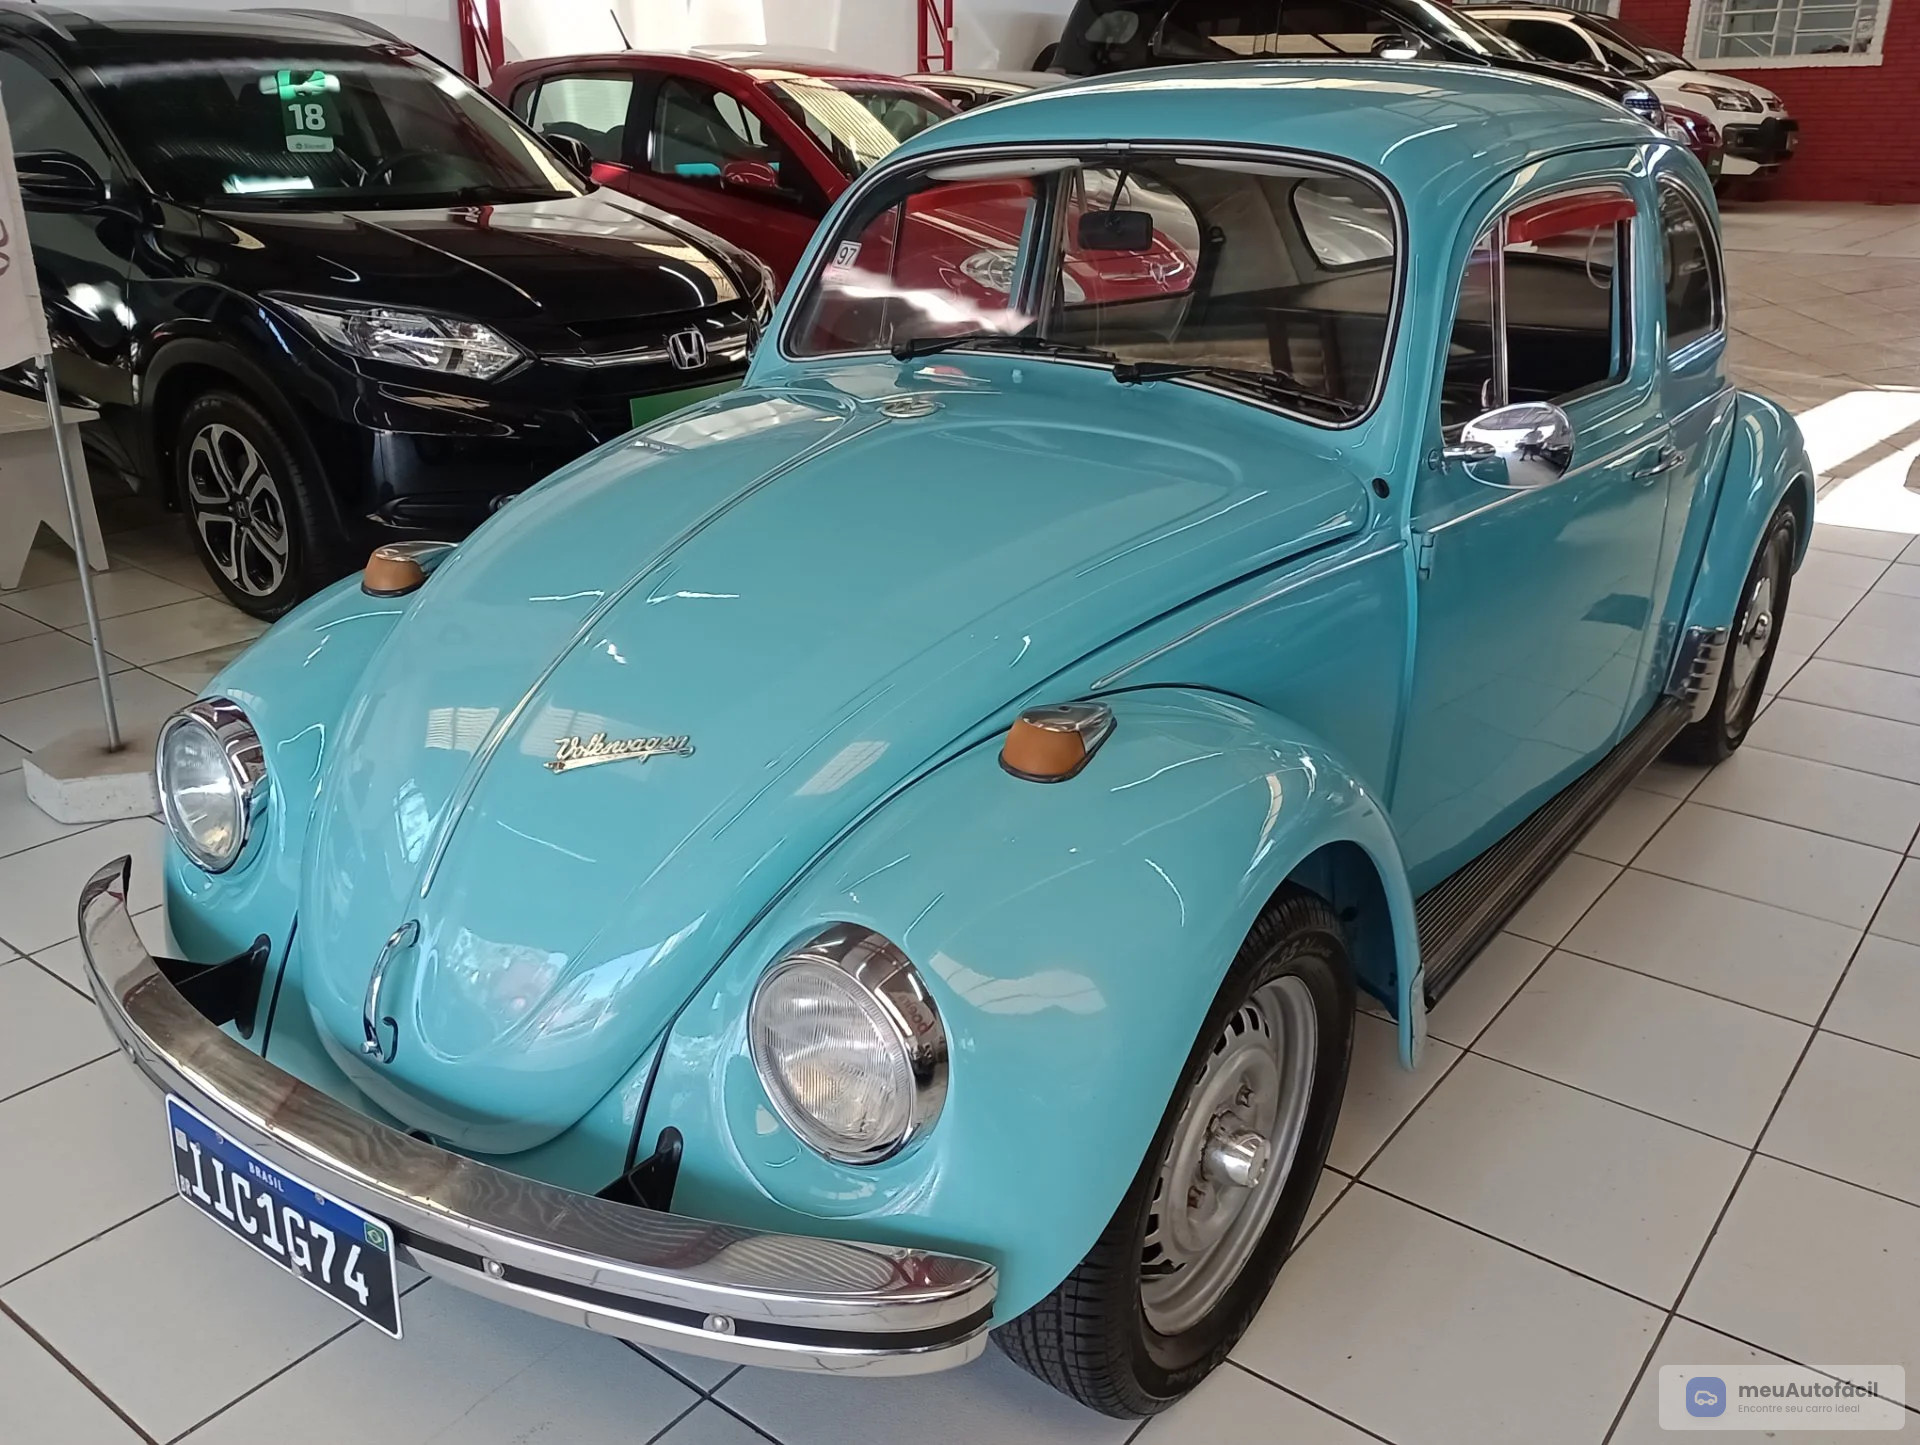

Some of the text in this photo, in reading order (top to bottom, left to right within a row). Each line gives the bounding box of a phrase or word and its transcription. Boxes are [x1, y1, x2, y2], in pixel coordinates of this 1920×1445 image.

[288, 104, 326, 130] 18
[837, 246, 857, 265] 97
[179, 1174, 192, 1197] BR
[248, 1161, 284, 1193] BRASIL
[189, 1141, 369, 1306] IIC1G74
